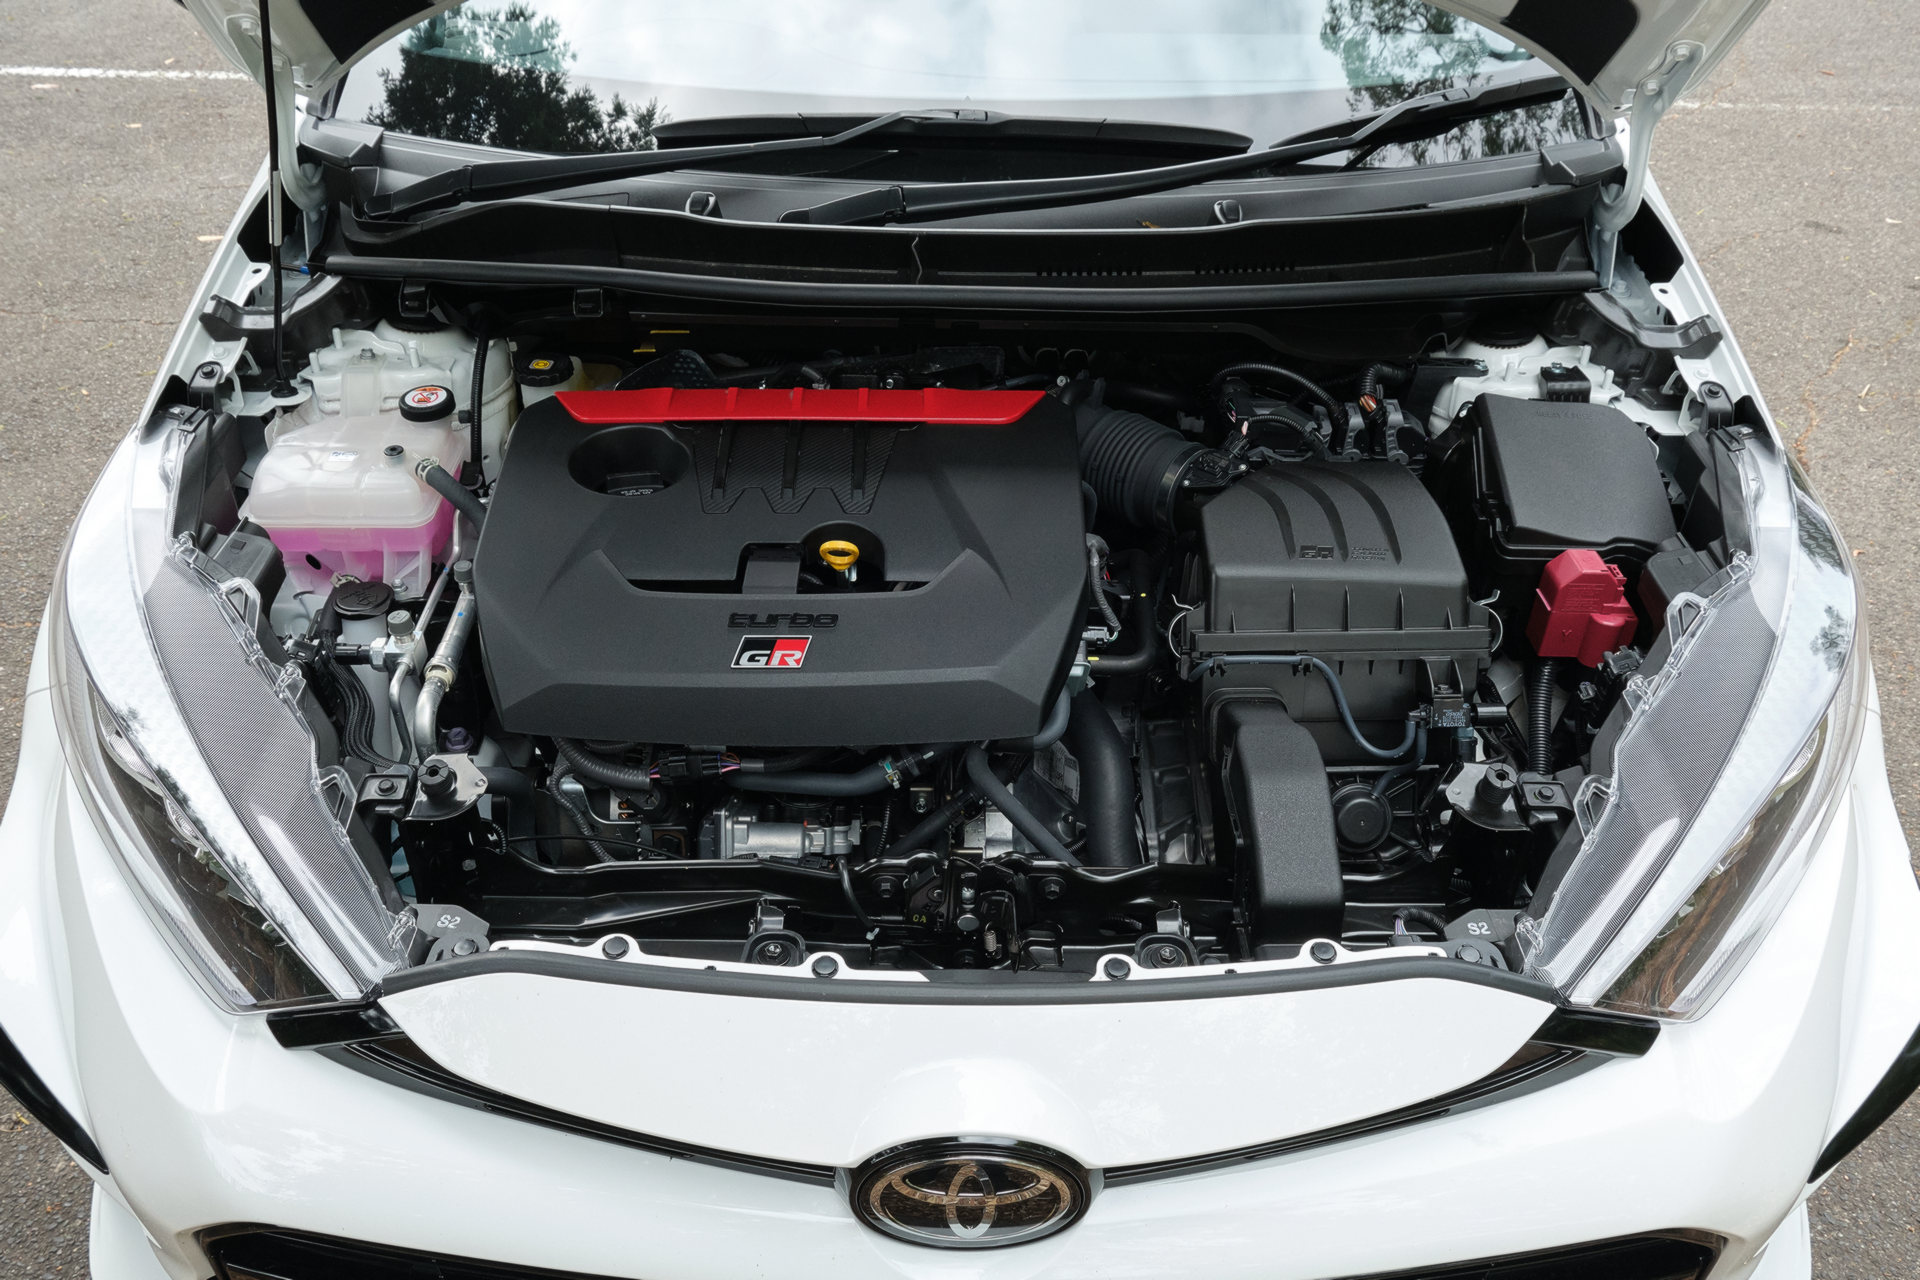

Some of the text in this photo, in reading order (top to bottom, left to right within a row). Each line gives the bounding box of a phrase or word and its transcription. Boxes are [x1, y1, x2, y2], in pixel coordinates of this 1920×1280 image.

[739, 649, 803, 666] GR
[436, 914, 461, 928] S2
[1467, 921, 1491, 935] S2
